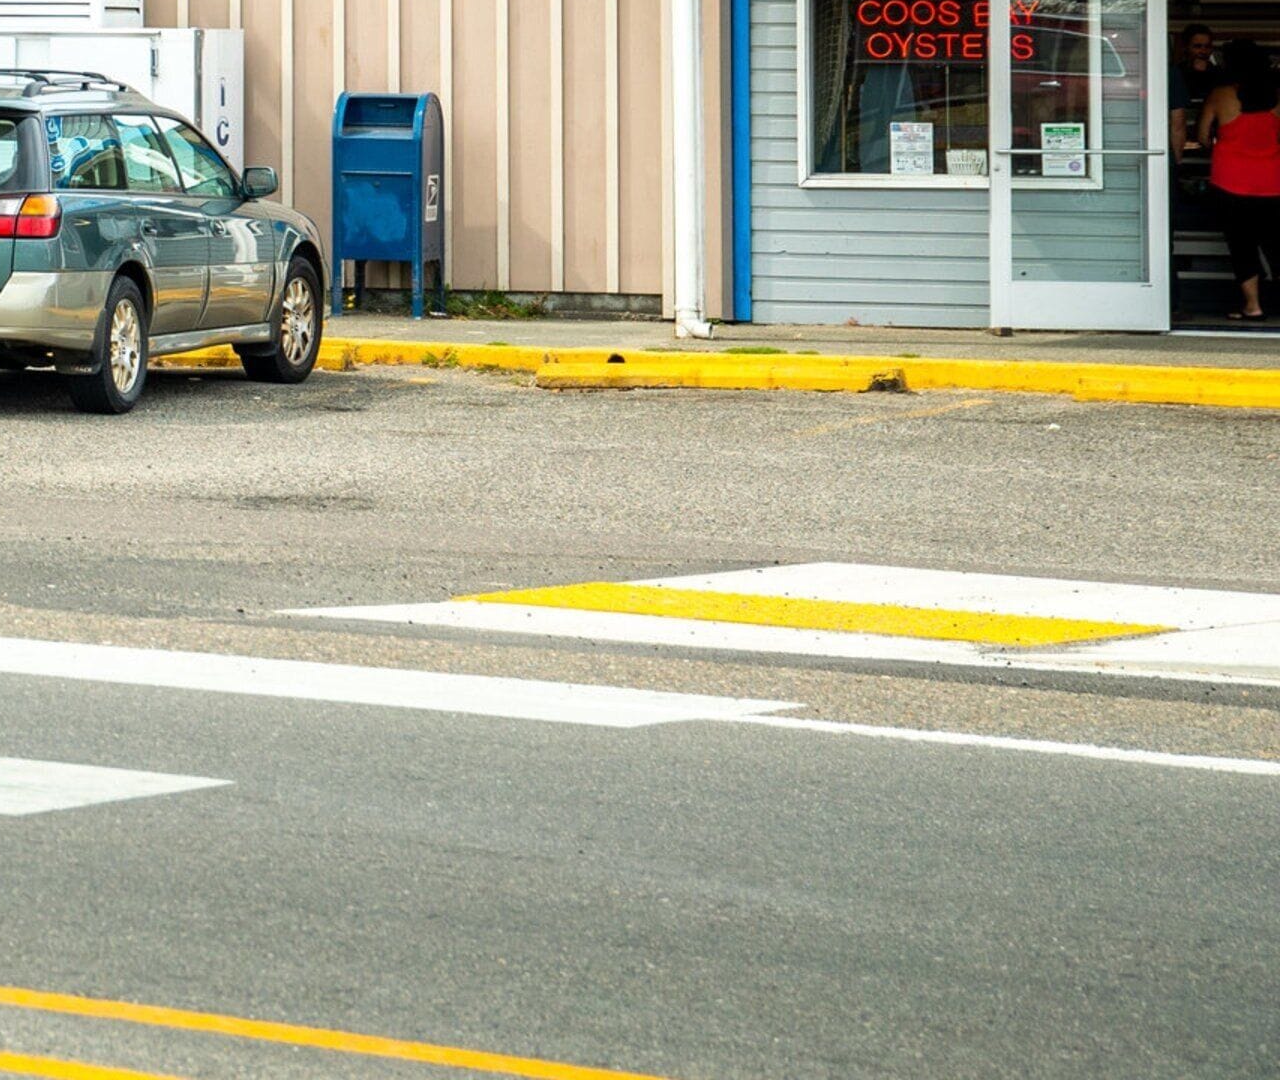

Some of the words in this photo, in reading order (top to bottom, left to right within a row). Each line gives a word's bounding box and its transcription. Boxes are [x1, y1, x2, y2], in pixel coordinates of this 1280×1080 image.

[857, 0, 961, 27] COOS
[866, 32, 1035, 60] OYSTES
[216, 76, 230, 158] IC
